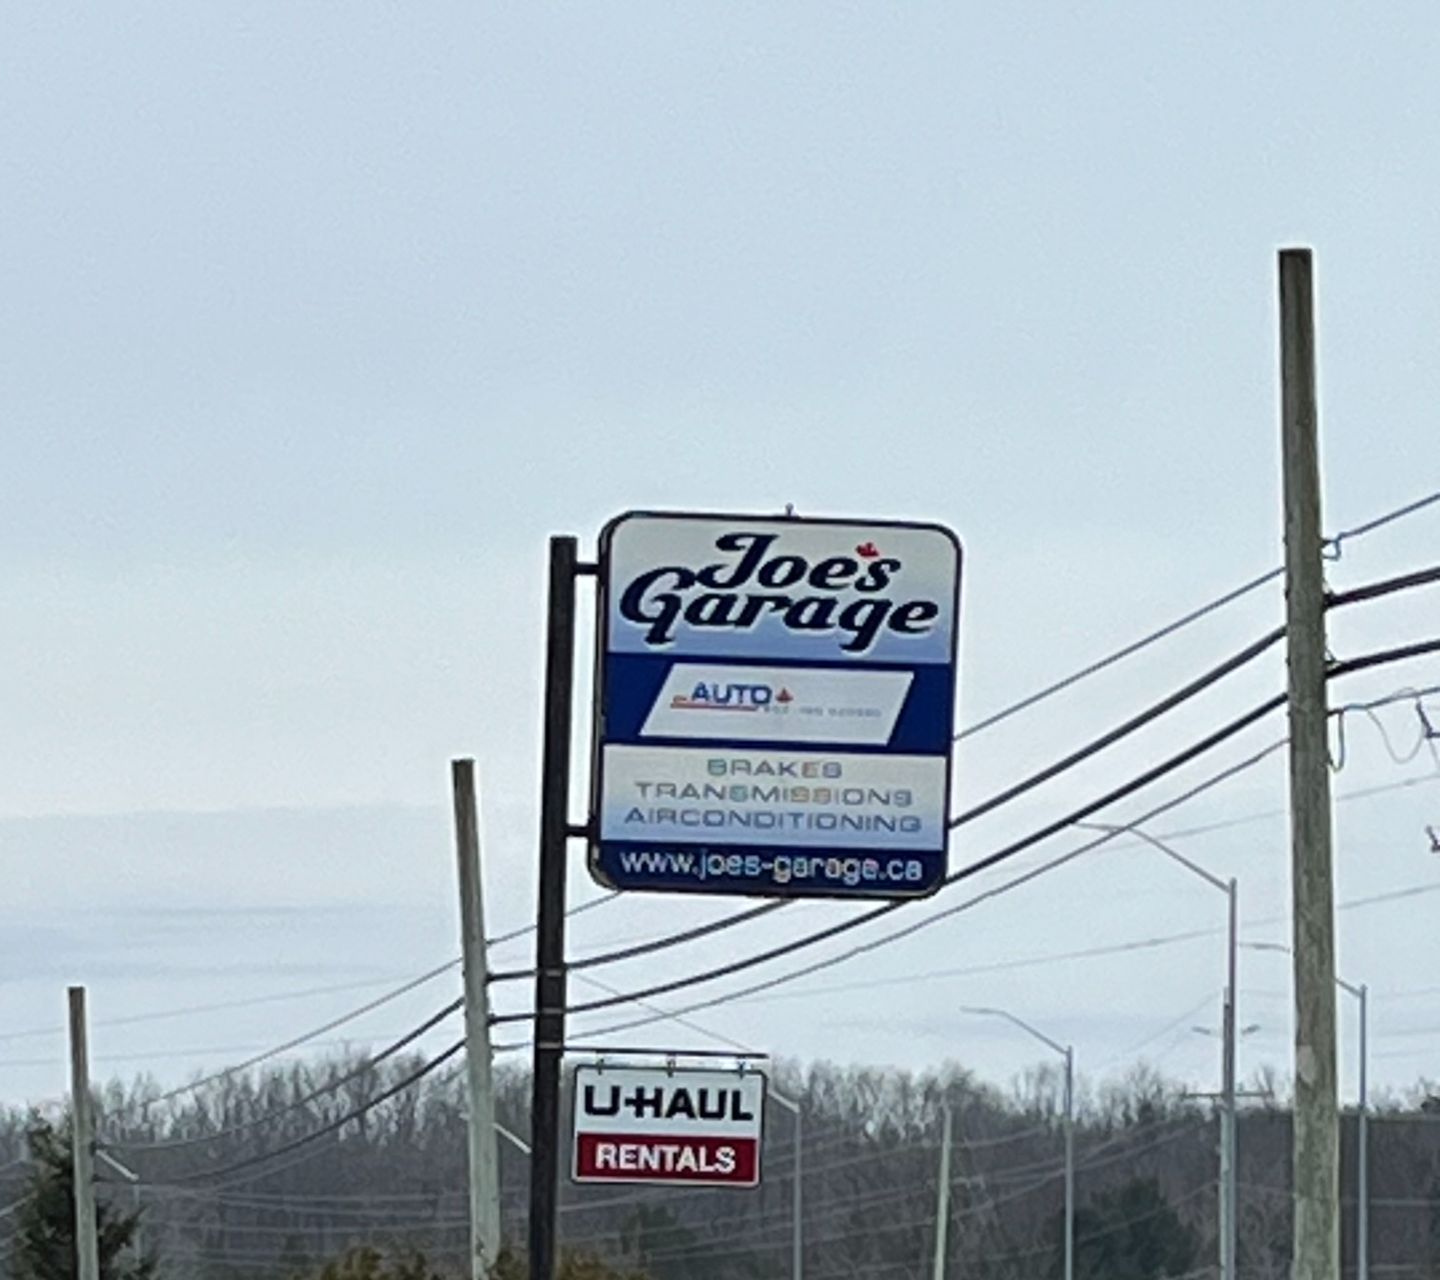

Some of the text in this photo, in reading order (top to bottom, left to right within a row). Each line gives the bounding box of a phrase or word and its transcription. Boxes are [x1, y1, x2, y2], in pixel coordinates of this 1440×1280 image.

[619, 565, 939, 653] Garage
[691, 681, 773, 706] AUTO
[706, 758, 843, 779] BRAKES
[635, 781, 913, 807] TRANSMISSIONS
[624, 807, 922, 833] AIRCONDITIONING
[620, 850, 923, 885] www.joes-garage.ca
[584, 1084, 754, 1121] U-HAUL
[595, 1142, 736, 1173] RENTALS
